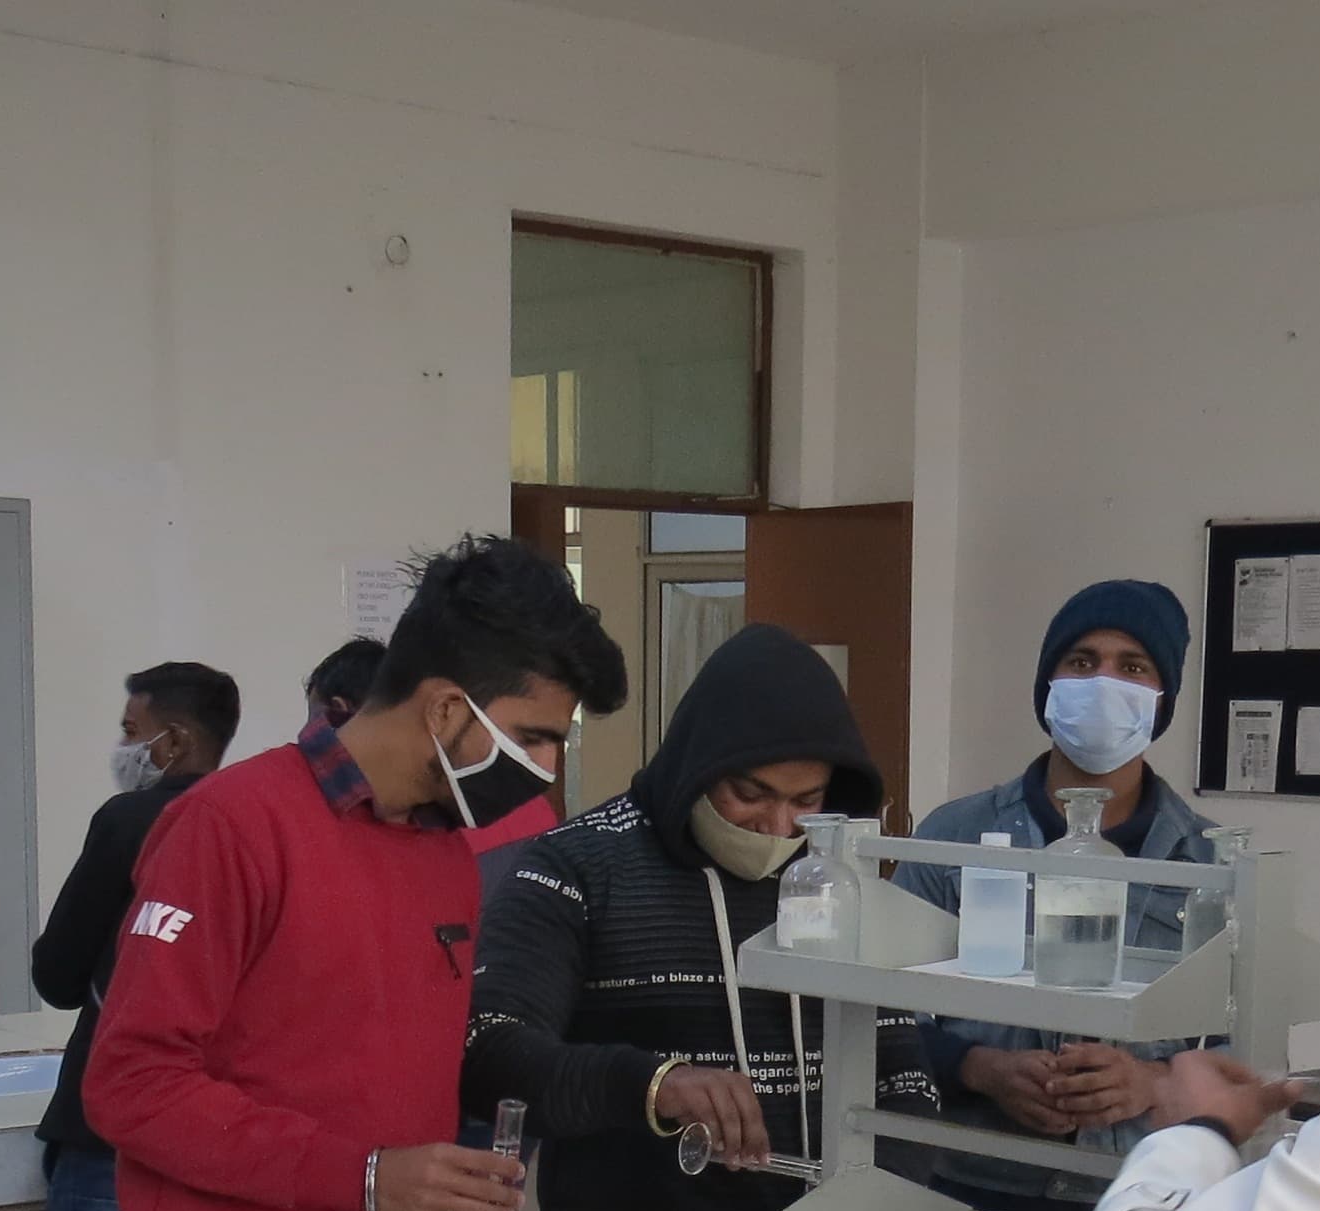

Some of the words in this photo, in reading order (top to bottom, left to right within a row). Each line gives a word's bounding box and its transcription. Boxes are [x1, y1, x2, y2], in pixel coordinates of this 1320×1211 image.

[516, 869, 562, 890] casual
[652, 974, 666, 983] to
[669, 972, 704, 983] blaze
[707, 975, 715, 983] a
[748, 1052, 760, 1062] to
[763, 1051, 794, 1062] blaze
[805, 1064, 817, 1076] in
[752, 1081, 774, 1094] the
